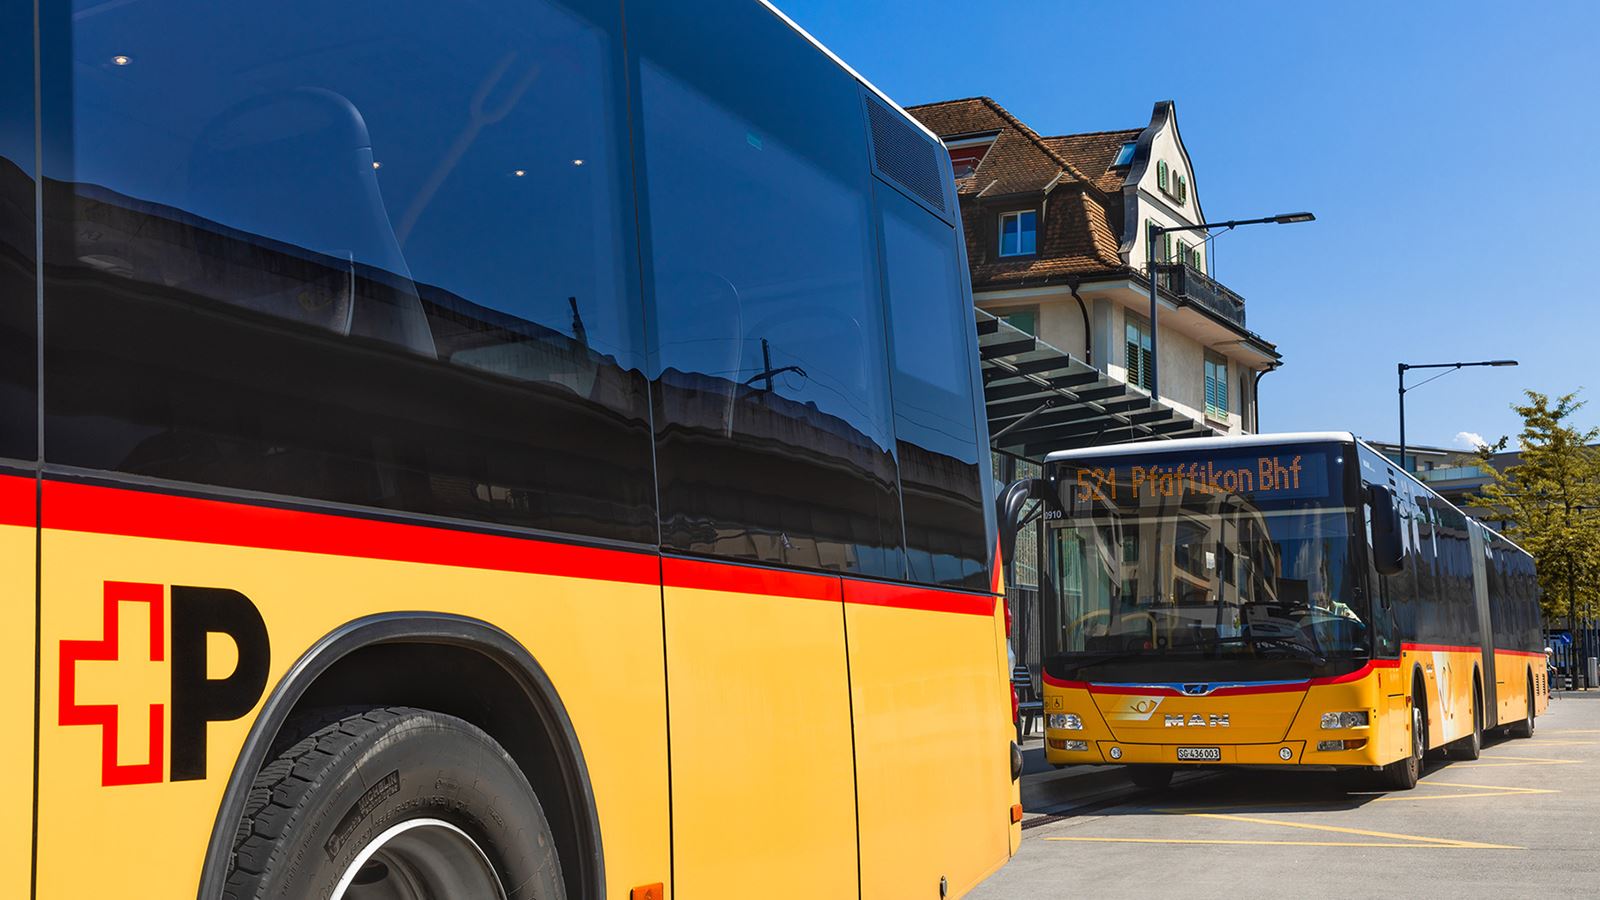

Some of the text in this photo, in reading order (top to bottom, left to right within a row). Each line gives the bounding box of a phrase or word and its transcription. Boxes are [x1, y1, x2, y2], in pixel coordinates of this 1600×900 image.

[1077, 455, 1302, 501] 521 Pfäffikon Bhf
[169, 584, 271, 782] P
[1165, 714, 1230, 727] MAN
